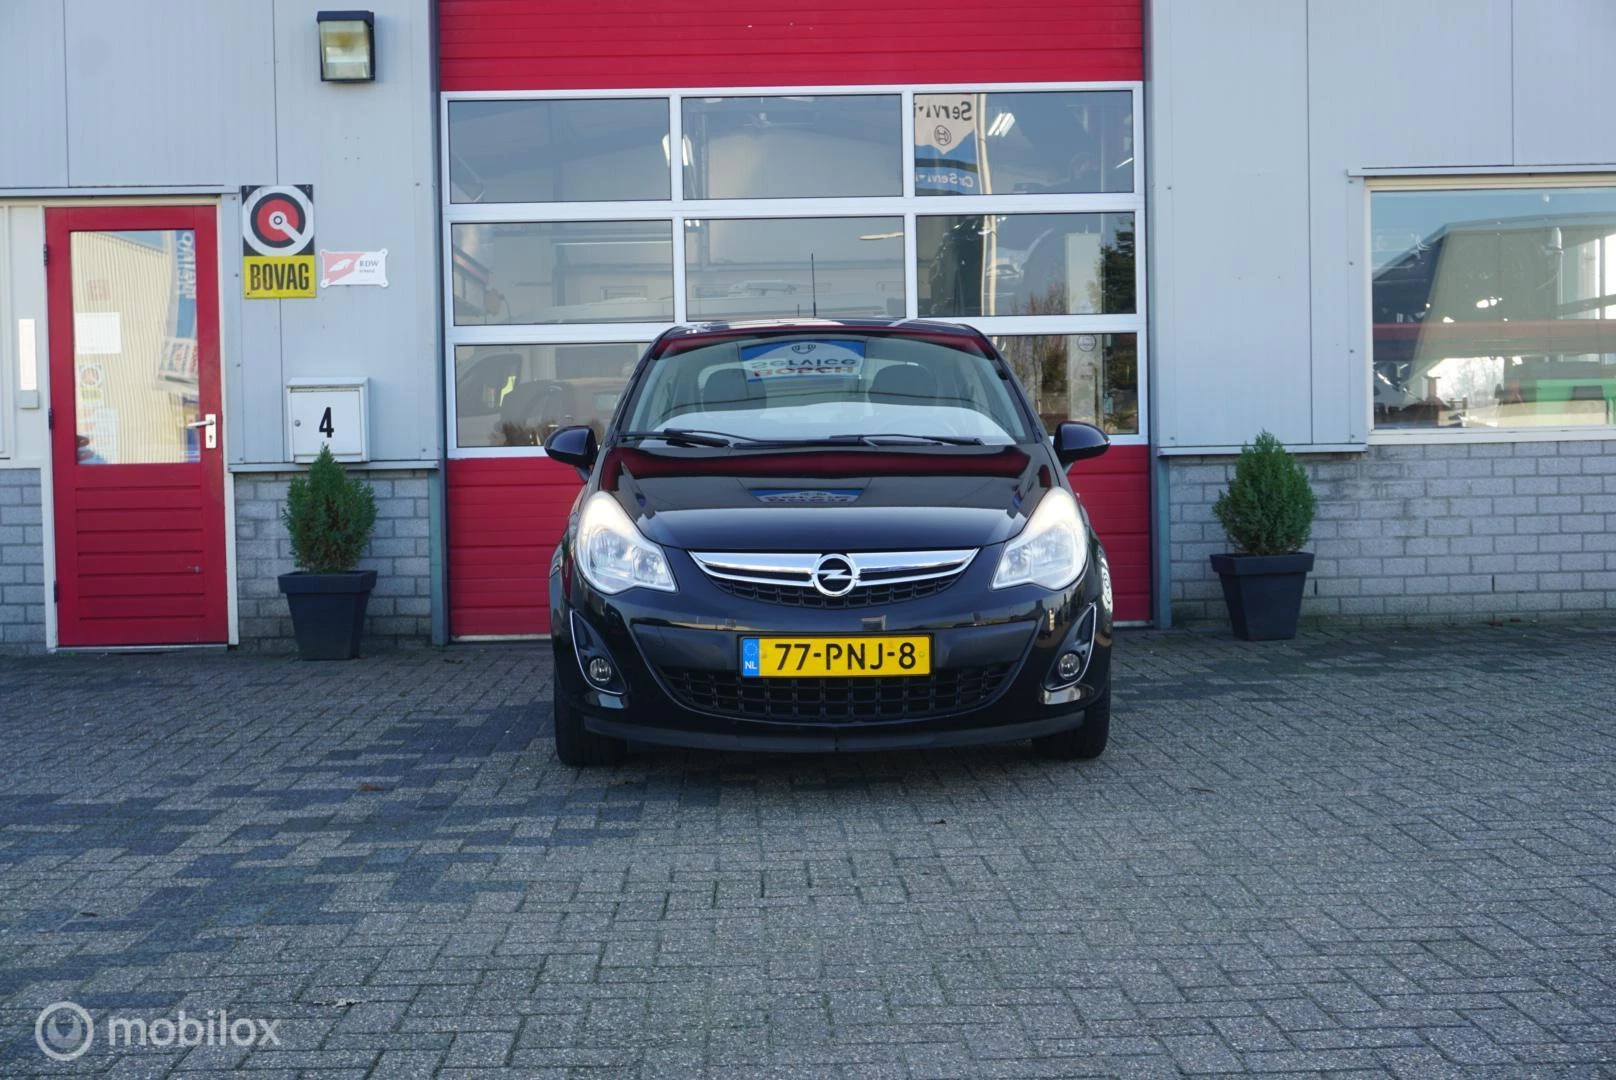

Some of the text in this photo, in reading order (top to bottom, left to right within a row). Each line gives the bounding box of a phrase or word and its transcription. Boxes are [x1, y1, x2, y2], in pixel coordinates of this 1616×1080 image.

[249, 262, 310, 291] BOVAG
[319, 406, 335, 438] 4
[744, 642, 917, 671] NL 77-PNJ-8
